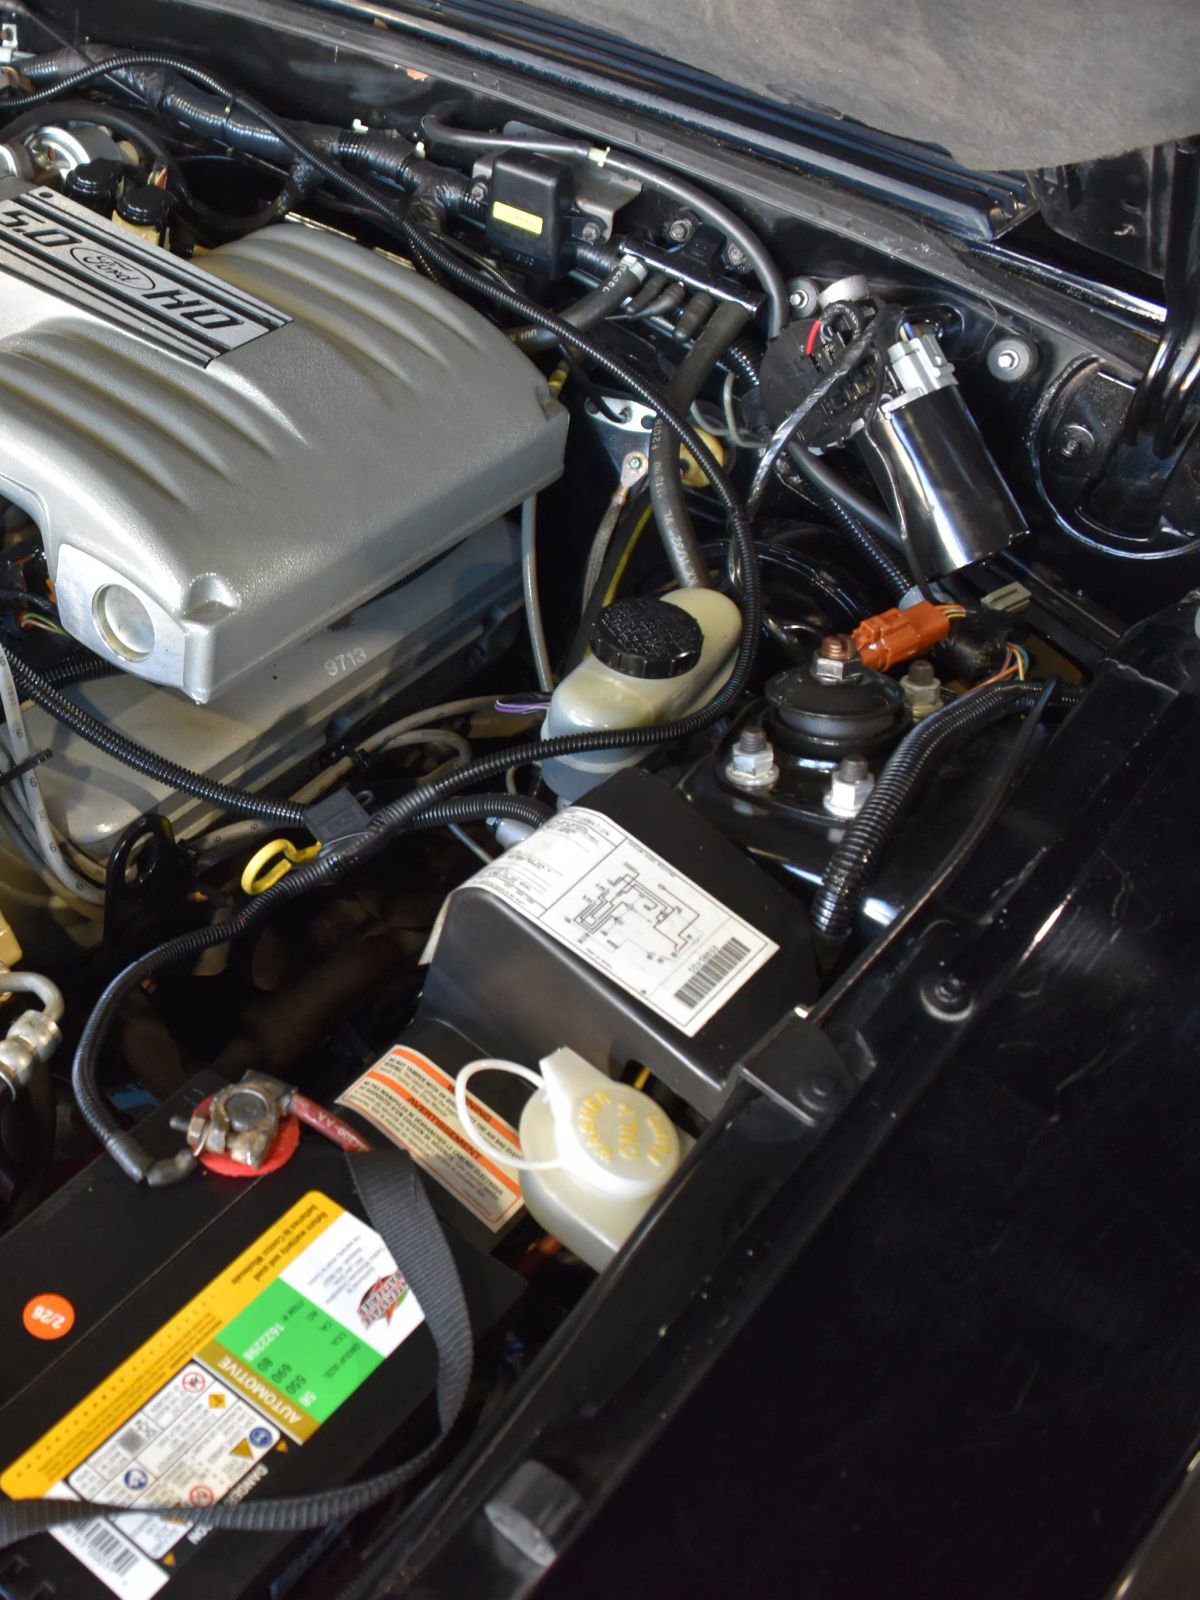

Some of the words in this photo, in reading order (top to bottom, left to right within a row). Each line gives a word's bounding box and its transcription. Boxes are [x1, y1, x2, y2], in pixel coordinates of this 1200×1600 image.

[83, 250, 141, 284] Ford
[141, 288, 246, 329] HO
[323, 647, 368, 677] 9713
[447, 1082, 492, 1124] WNING
[406, 1097, 481, 1161] AVERTISSEMENT
[579, 1088, 614, 1165] WASHER
[619, 1103, 639, 1161] ONLY
[30, 1304, 66, 1331] 2/26
[329, 1329, 347, 1349] CCA
[255, 1354, 275, 1374] 80
[269, 1360, 294, 1386] 690
[217, 1356, 302, 1425] AUTOMOTIVE
[284, 1371, 308, 1397] 550
